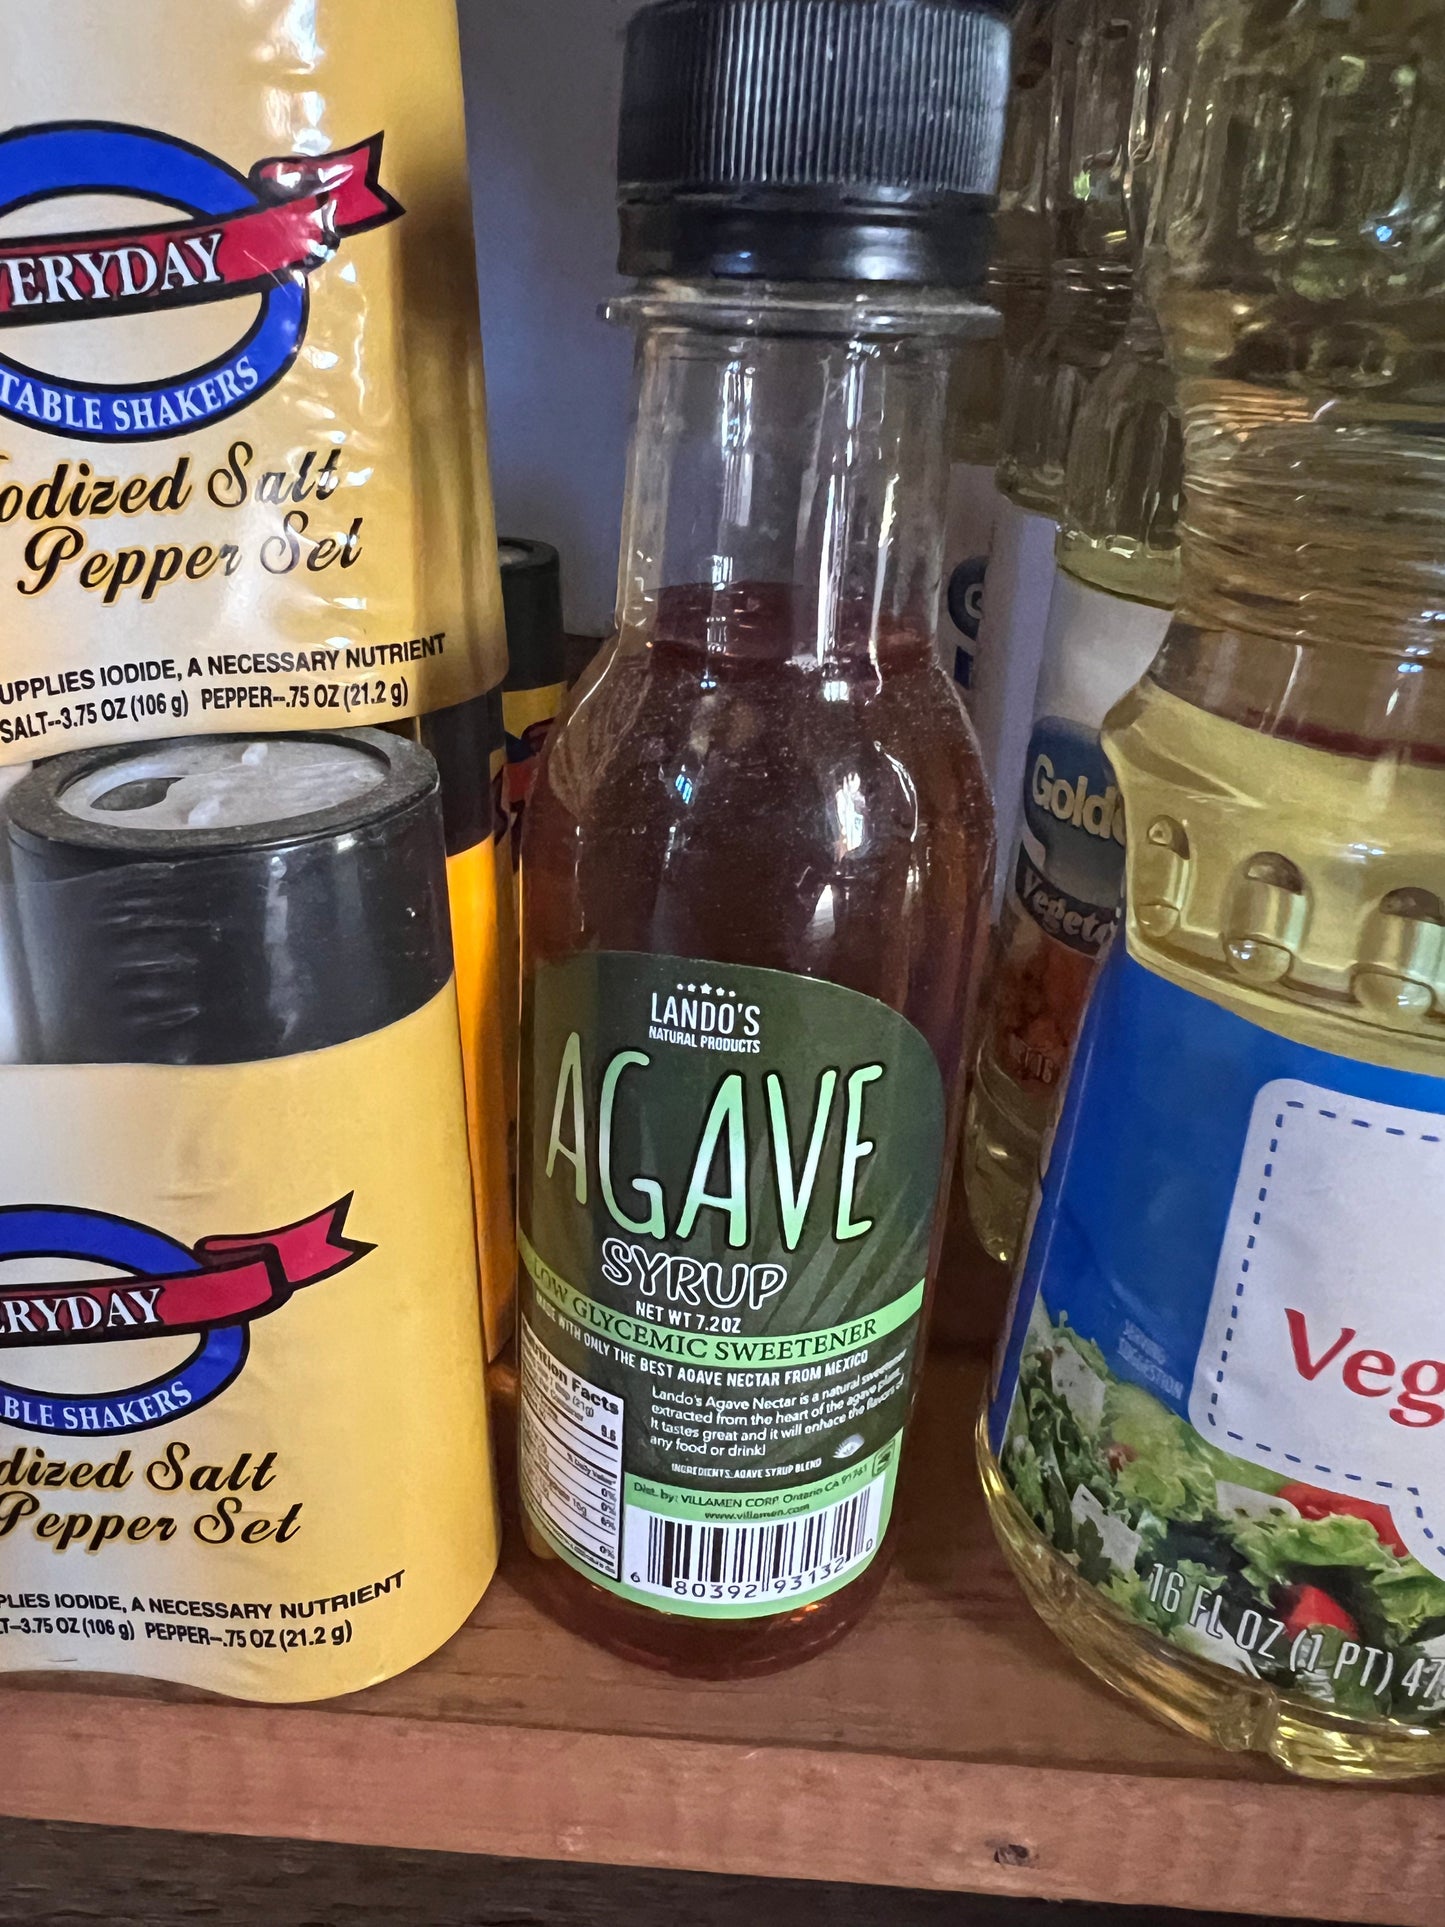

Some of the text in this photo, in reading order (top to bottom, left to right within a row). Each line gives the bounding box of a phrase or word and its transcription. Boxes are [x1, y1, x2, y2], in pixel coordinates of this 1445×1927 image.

[0, 234, 225, 307] ERYDAY
[0, 356, 259, 431] TABLE SHAKERS
[0, 441, 342, 523] odized Salt
[17, 510, 363, 603] Pepper Set
[0, 633, 446, 705] UPPLIES IODIDE, A NECESSARY NUTRIENT
[101, 697, 128, 721] OZ
[130, 694, 167, 722] (106
[171, 690, 189, 718] g)
[314, 684, 340, 708] OZ
[343, 681, 387, 713] (21.2
[391, 676, 409, 708] g)
[651, 992, 761, 1036] LANDO'S
[649, 1025, 760, 1054] NATURAL PRODUCTS
[546, 1032, 884, 1251] AGAVE
[602, 1237, 788, 1310] SYRUP
[0, 1288, 161, 1333] RYDAY
[533, 1260, 877, 1361] LOW GLYCEMIC SWEETENER
[636, 1300, 664, 1322] NET
[669, 1309, 692, 1328] WT
[559, 1314, 581, 1342] WITH
[584, 1332, 610, 1357] ONLY
[613, 1346, 636, 1369] THE
[640, 1357, 674, 1379] BEST
[677, 1367, 722, 1386] AGAVE
[726, 1372, 780, 1387] NECTAR
[784, 1366, 822, 1385] FROM
[825, 1350, 868, 1377] MEXICO
[1284, 1308, 1445, 1428] Veg
[0, 1381, 192, 1430] BLE SHAKERS
[572, 1376, 619, 1415] Facts
[651, 1405, 713, 1424] extracted
[716, 1411, 748, 1426] from
[750, 1413, 773, 1426] the
[776, 1410, 808, 1424] heart
[811, 1402, 825, 1418] of
[826, 1400, 844, 1414] the
[652, 1384, 702, 1407] Lando's
[705, 1396, 750, 1412] Agave
[752, 1396, 797, 1410] Nectar
[800, 1392, 809, 1405] is
[812, 1392, 820, 1403] a
[822, 1374, 860, 1400] natural
[650, 1435, 673, 1451] any
[676, 1438, 707, 1455] food
[710, 1446, 725, 1456] or
[651, 1417, 659, 1431] It
[662, 1421, 699, 1438] tastes
[703, 1429, 738, 1442] great
[741, 1427, 767, 1441] and
[770, 1427, 778, 1440] it
[781, 1423, 802, 1439] will
[147, 1441, 278, 1492] Salt
[681, 1494, 742, 1508] VILLAMEN
[783, 1488, 823, 1503] Ontario
[825, 1480, 839, 1492] CA
[0, 1490, 303, 1551] Pepper Set
[54, 1593, 127, 1613] IODIDE,
[131, 1597, 145, 1612] A
[148, 1598, 272, 1619] NECESSARY
[280, 1569, 405, 1618] NUTRIENT
[630, 1572, 641, 1583] 6
[674, 1581, 758, 1599] 80392
[774, 1556, 845, 1594] 93132
[56, 1617, 80, 1634] OZ
[82, 1617, 116, 1638] (106
[118, 1620, 135, 1641] g)
[250, 1629, 277, 1648] OZ
[279, 1626, 326, 1653] (21.2
[331, 1619, 352, 1645] g)
[1150, 1563, 1445, 1698] 16 FL OZ (1 PT) 47
